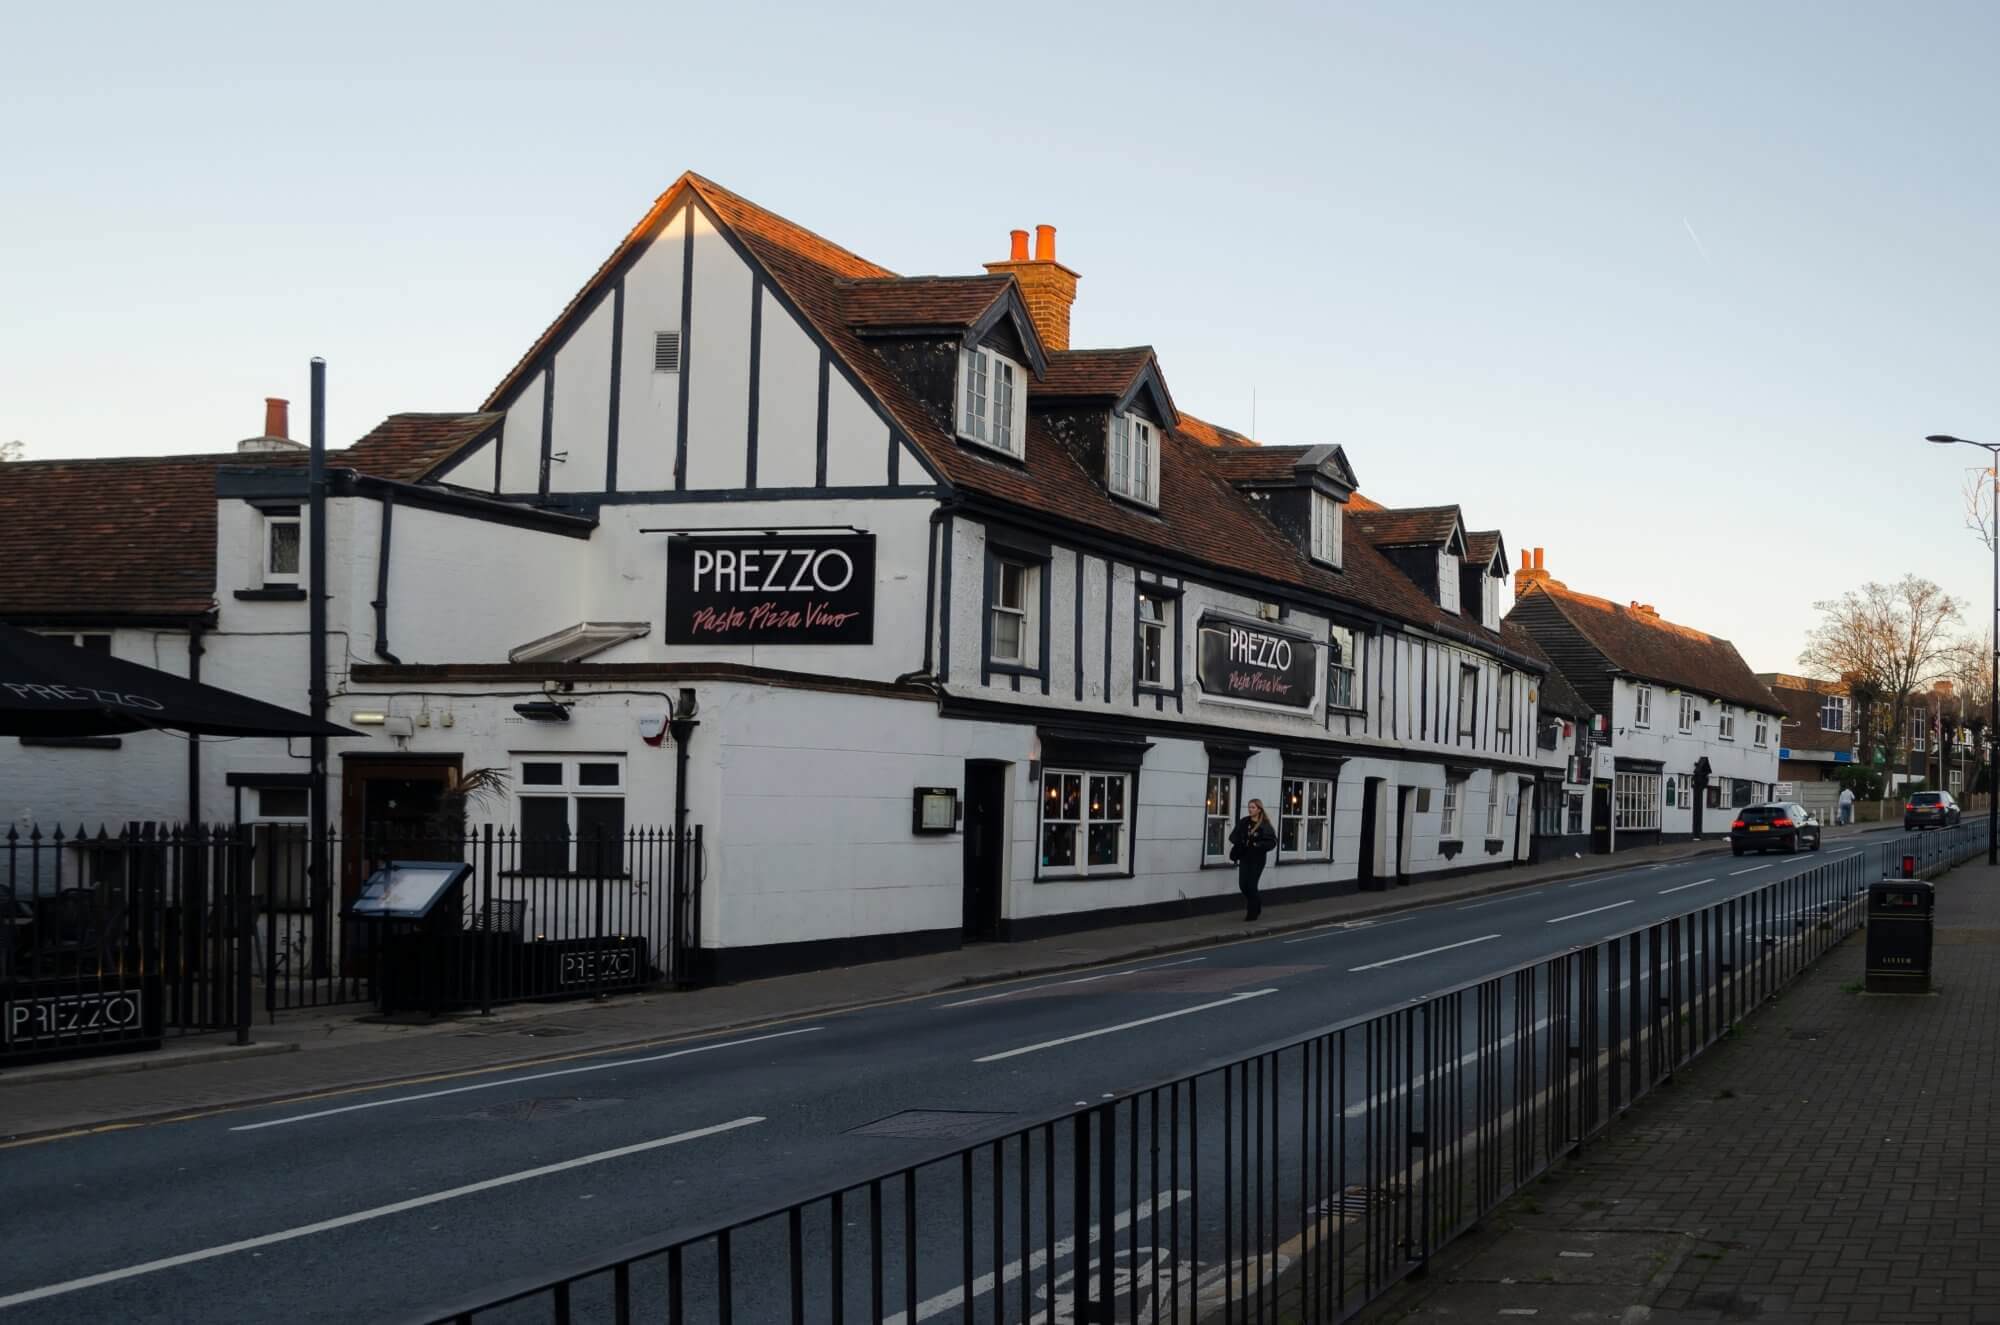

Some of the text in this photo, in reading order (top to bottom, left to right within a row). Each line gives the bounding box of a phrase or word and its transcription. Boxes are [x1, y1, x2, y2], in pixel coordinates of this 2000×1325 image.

[693, 548, 854, 592] PREZZO
[691, 601, 860, 634] Pasta Pizza Vino
[1229, 628, 1292, 672] PREZZO
[1, 682, 165, 711] PREZZO
[12, 997, 136, 1034] PREZZO
